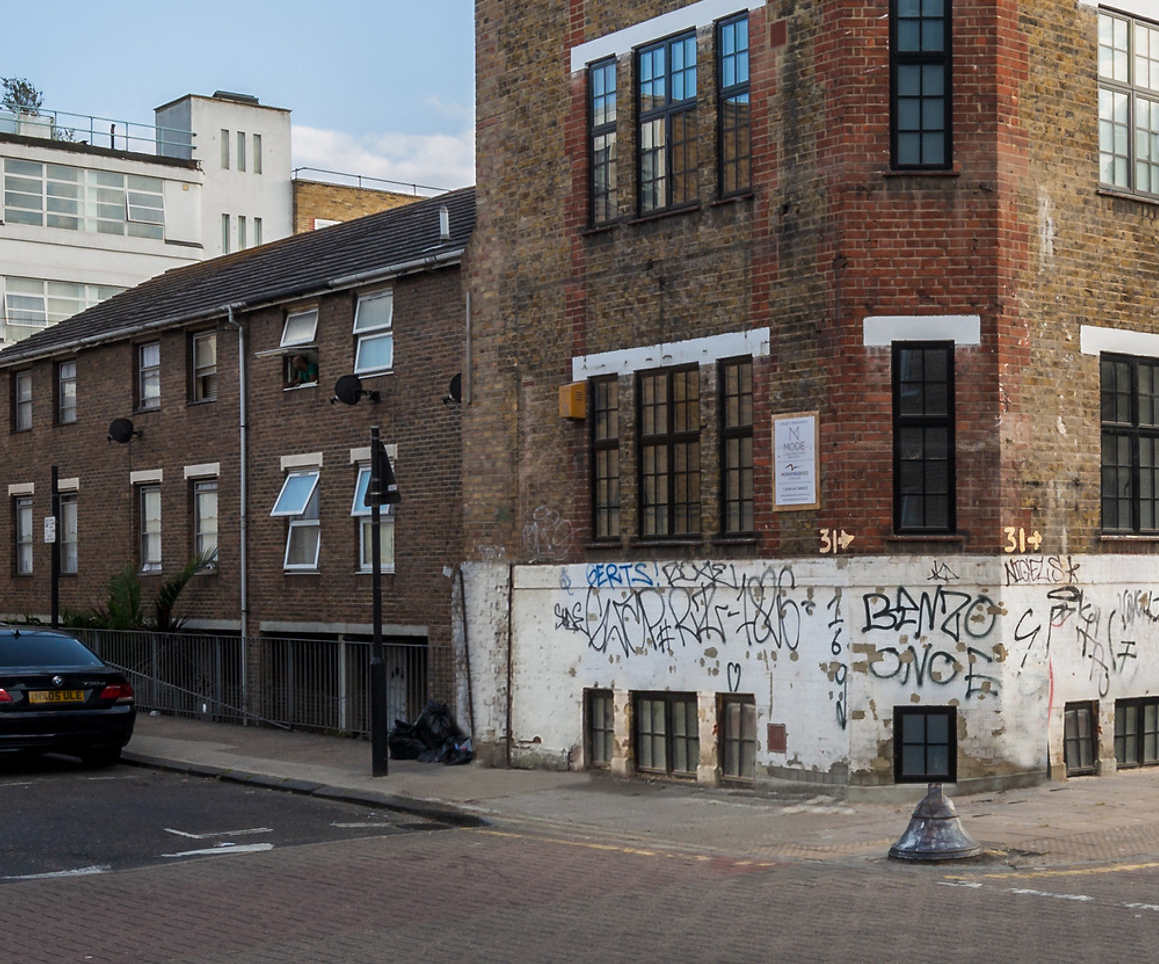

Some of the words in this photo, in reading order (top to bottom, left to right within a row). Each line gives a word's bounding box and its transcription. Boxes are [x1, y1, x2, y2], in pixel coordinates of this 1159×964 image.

[819, 528, 838, 554] 31
[1004, 526, 1026, 553] 31
[63, 691, 83, 701] ULE
